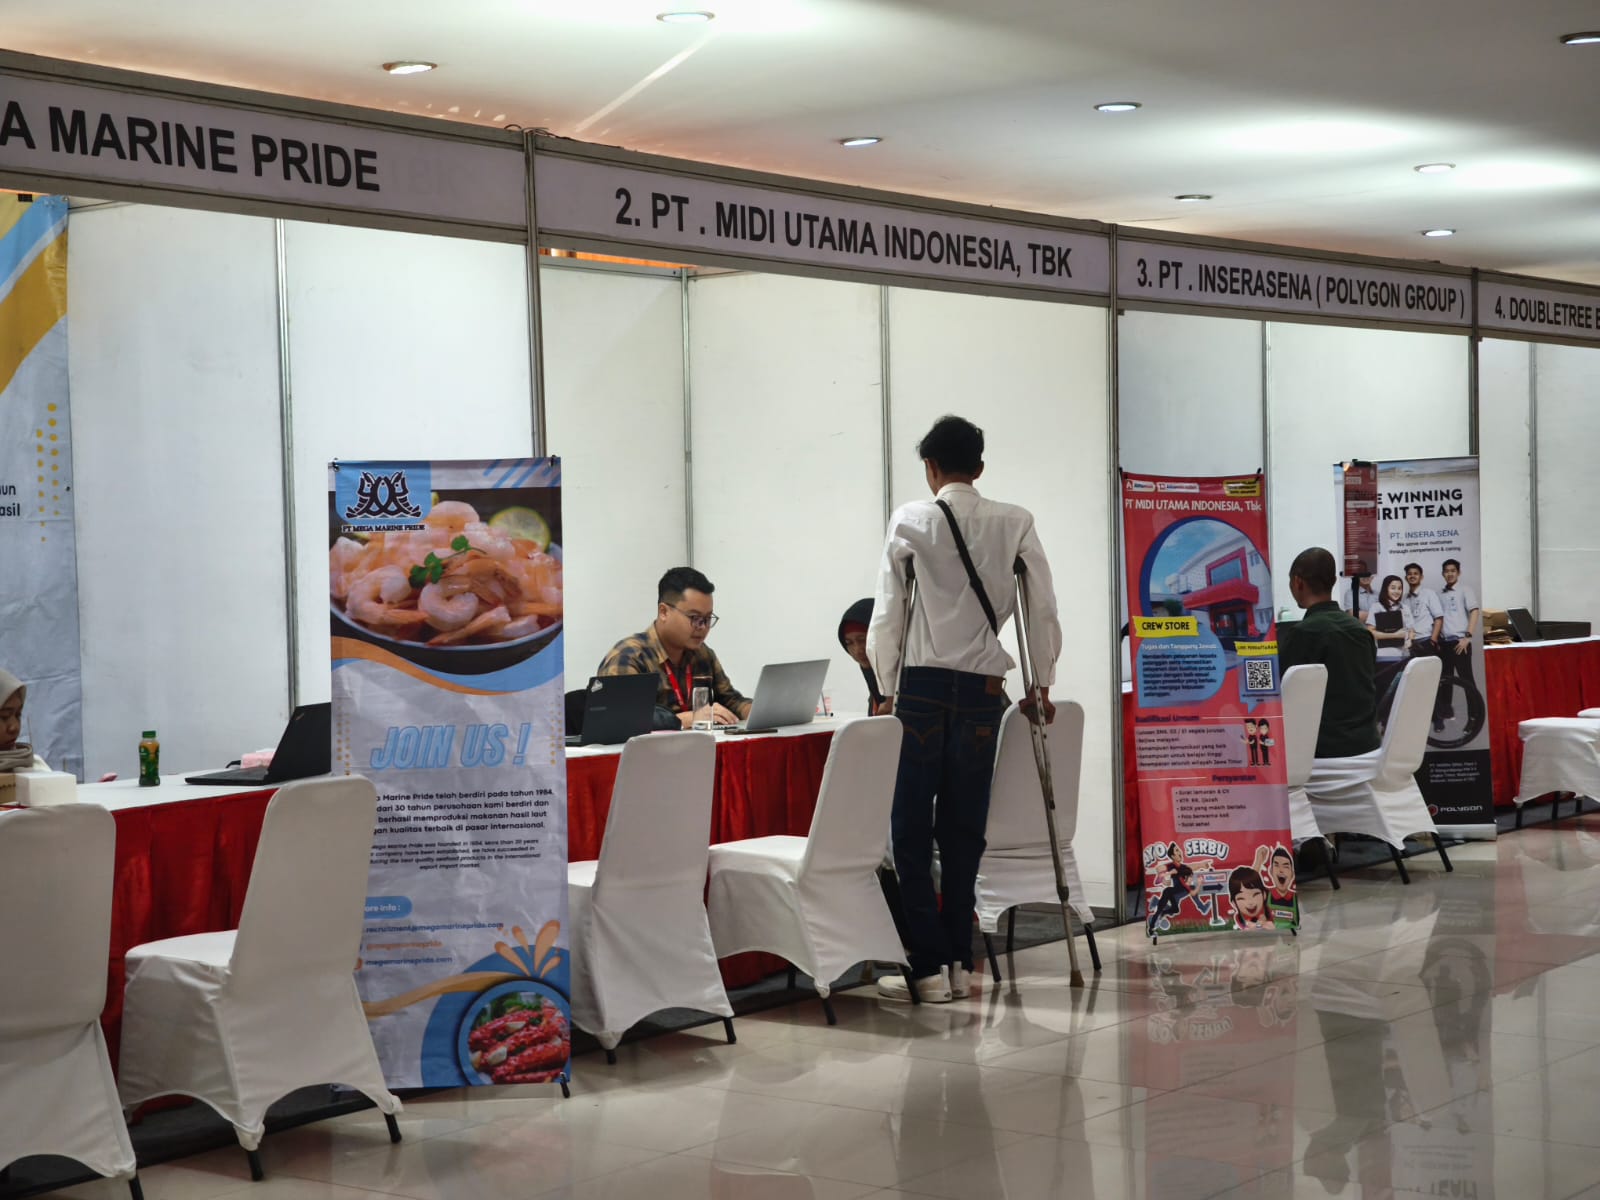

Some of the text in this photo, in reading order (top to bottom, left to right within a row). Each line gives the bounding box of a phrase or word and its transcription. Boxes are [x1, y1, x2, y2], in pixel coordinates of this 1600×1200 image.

[49, 106, 238, 174] MARINE
[252, 134, 380, 192] PRIDE
[615, 188, 641, 227] 2.
[652, 192, 689, 232] PT
[716, 202, 775, 243] MIDI
[784, 211, 878, 256] UTAMA
[885, 224, 1022, 279] INDONESIA,
[1028, 243, 1073, 279] TBK
[1137, 257, 1153, 288] 3.
[1159, 260, 1183, 291] PT
[1199, 264, 1312, 301] INSERASENA
[1326, 277, 1400, 309] POLYGON
[1405, 284, 1457, 313] GROUP
[1495, 295, 1506, 319] 4.
[1510, 297, 1592, 329] DOUBLETREE
[1388, 488, 1463, 505] WINNING
[1135, 499, 1154, 510] MIDI
[1155, 499, 1190, 510] UTAMA
[1191, 500, 1244, 513] INDONESIA,
[1245, 500, 1262, 512] Tbk
[1378, 503, 1464, 521] IRIT TEAM
[1405, 531, 1435, 539] INSERA
[1436, 529, 1459, 538] SENA
[1142, 621, 1190, 631] CREW STORE
[370, 725, 455, 770] JOIN
[460, 723, 509, 768] US
[436, 791, 457, 799] telah
[459, 791, 486, 799] berdiri
[487, 790, 508, 799] pada
[407, 803, 432, 811] tahun
[433, 802, 482, 812] perusahaan
[484, 801, 504, 809] kami
[506, 800, 532, 808] berdiri
[378, 810, 547, 823] berhasil memproduksi makanan hasil laut
[424, 825, 453, 833] terbaik
[465, 824, 489, 832] pasar
[1184, 839, 1229, 860] SERBU
